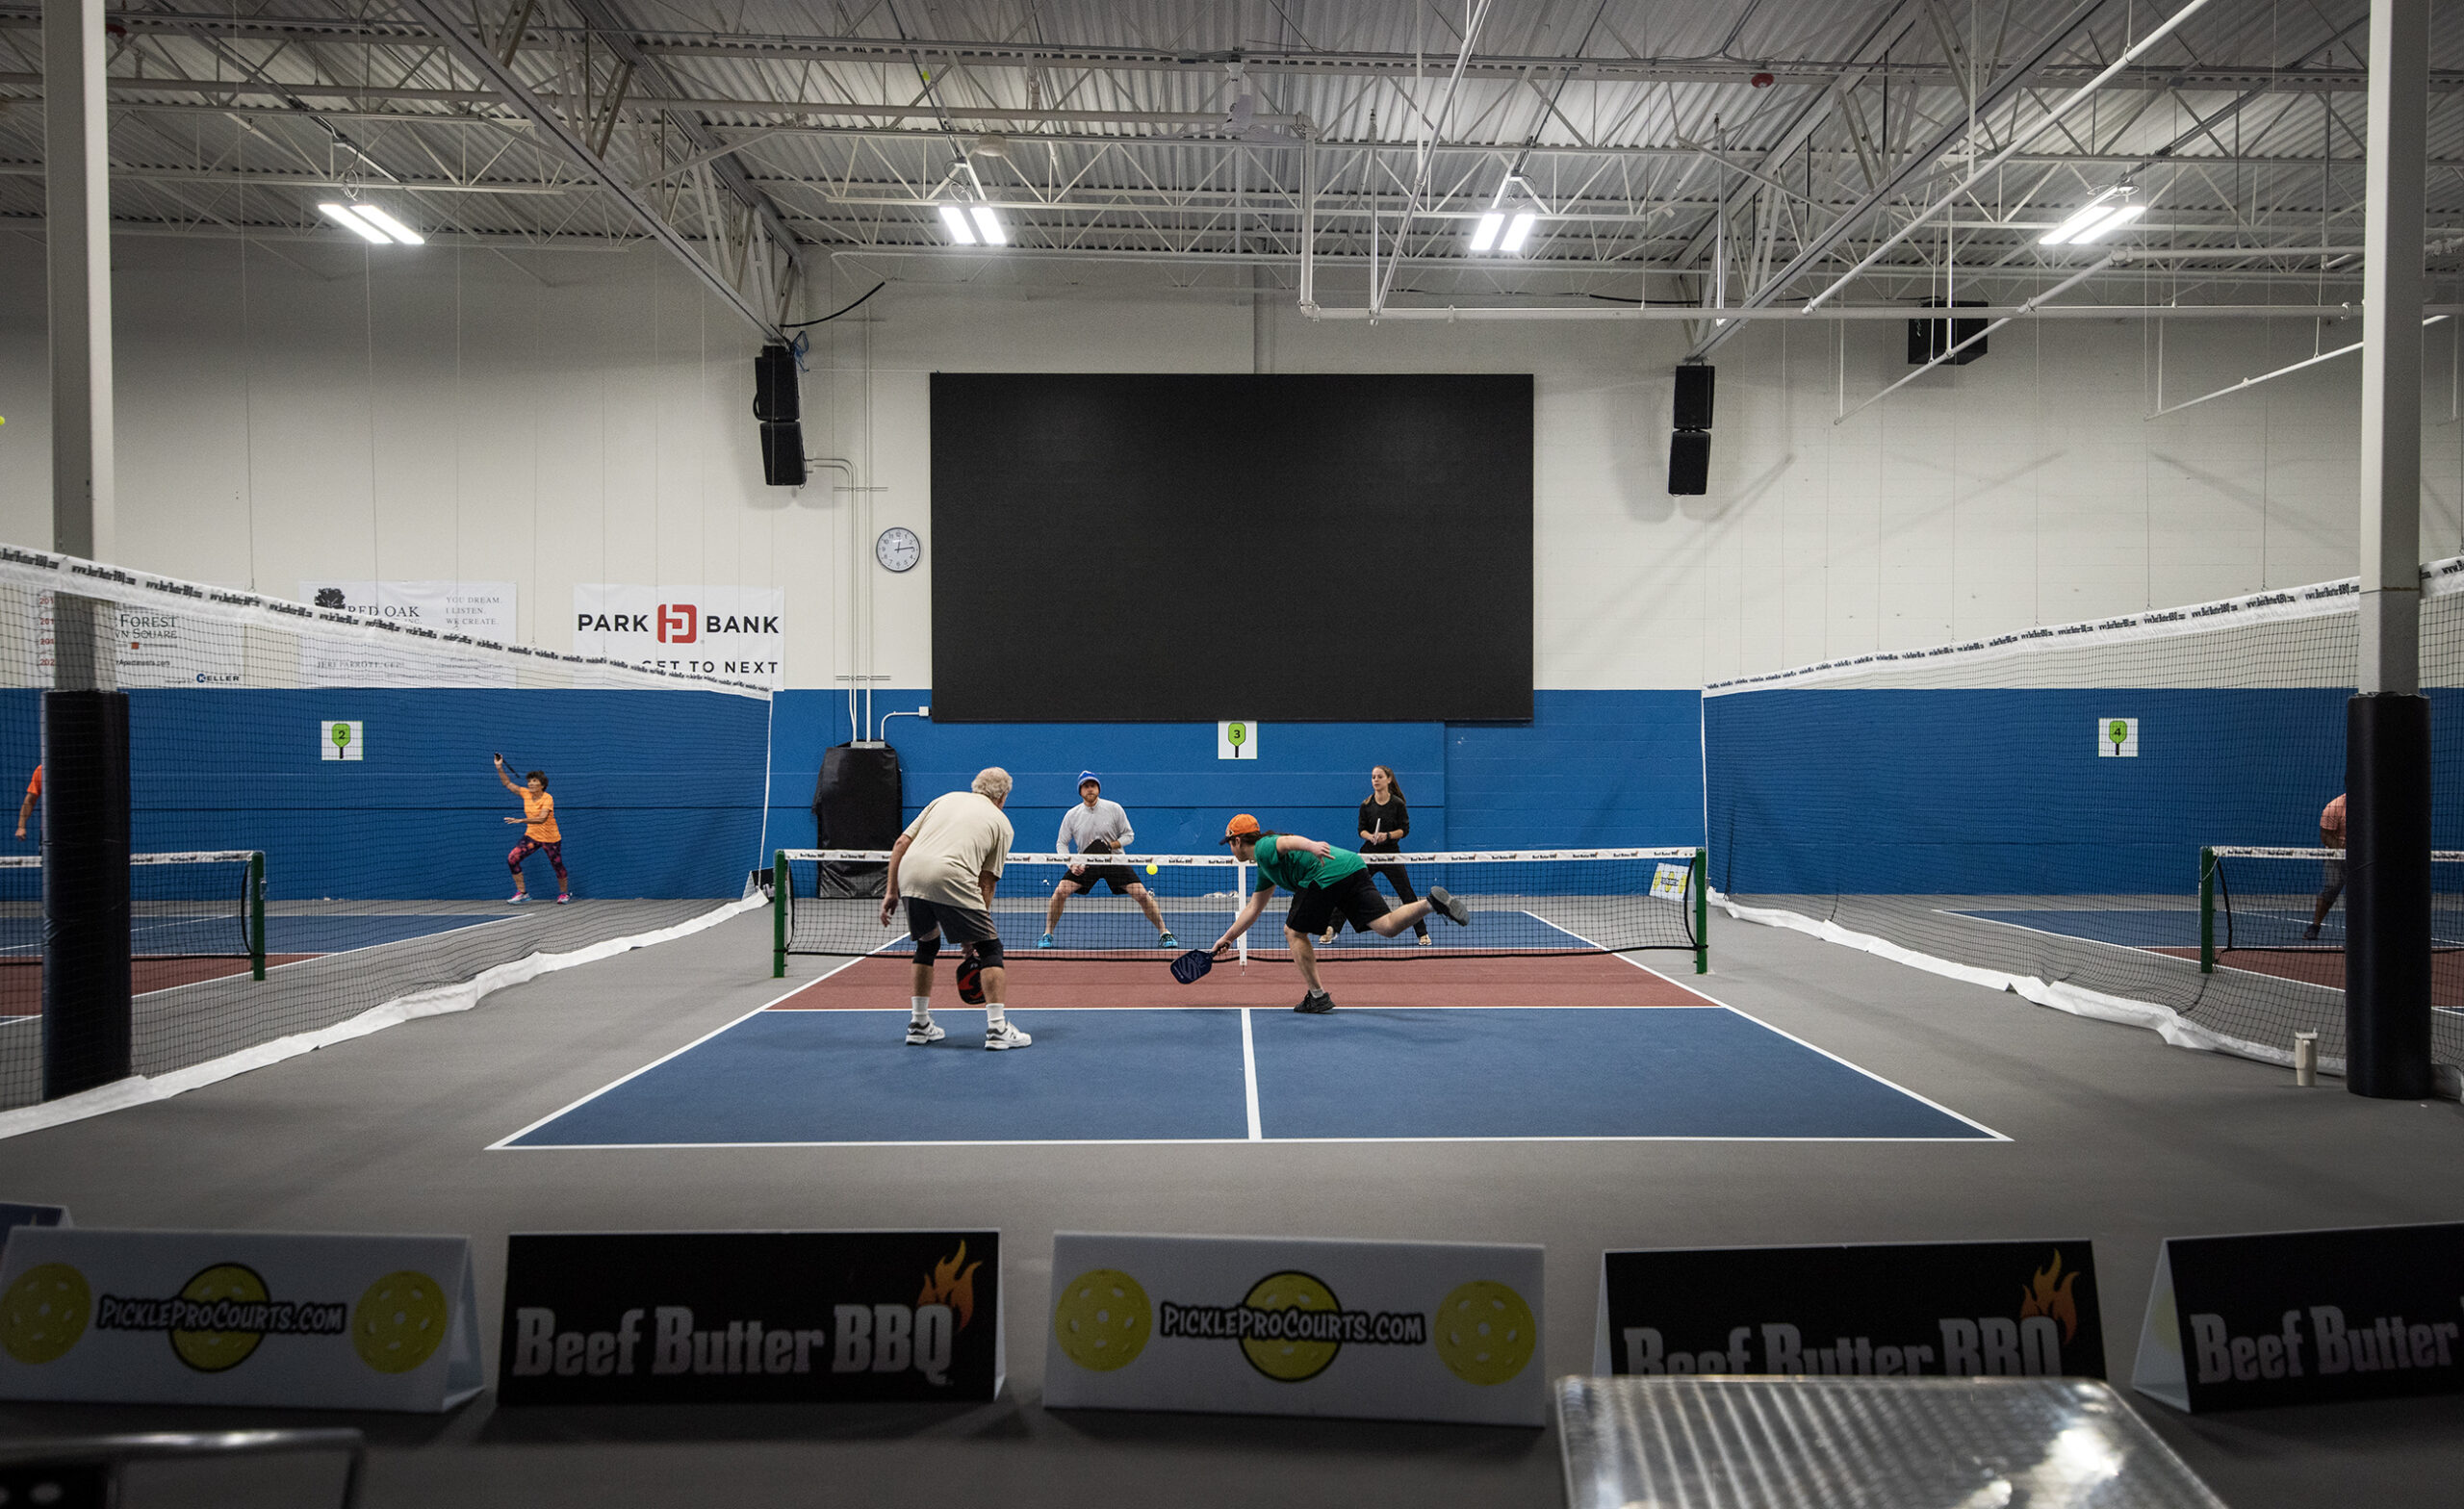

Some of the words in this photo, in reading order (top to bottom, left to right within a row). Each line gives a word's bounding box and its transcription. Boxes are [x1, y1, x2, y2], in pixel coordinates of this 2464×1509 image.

[385, 605, 420, 617] OAK
[578, 614, 649, 632] PARK
[706, 616, 779, 634] BANK
[689, 660, 714, 673] TO
[725, 662, 779, 674] NEXT
[338, 730, 346, 739] 2
[1233, 729, 1241, 739] 3
[2114, 728, 2121, 736] 4
[513, 1307, 645, 1376] Beef
[652, 1306, 825, 1376] Butter
[832, 1304, 953, 1386] BBQ
[2190, 1310, 2304, 1384] Beef
[2310, 1305, 2457, 1375] Butter
